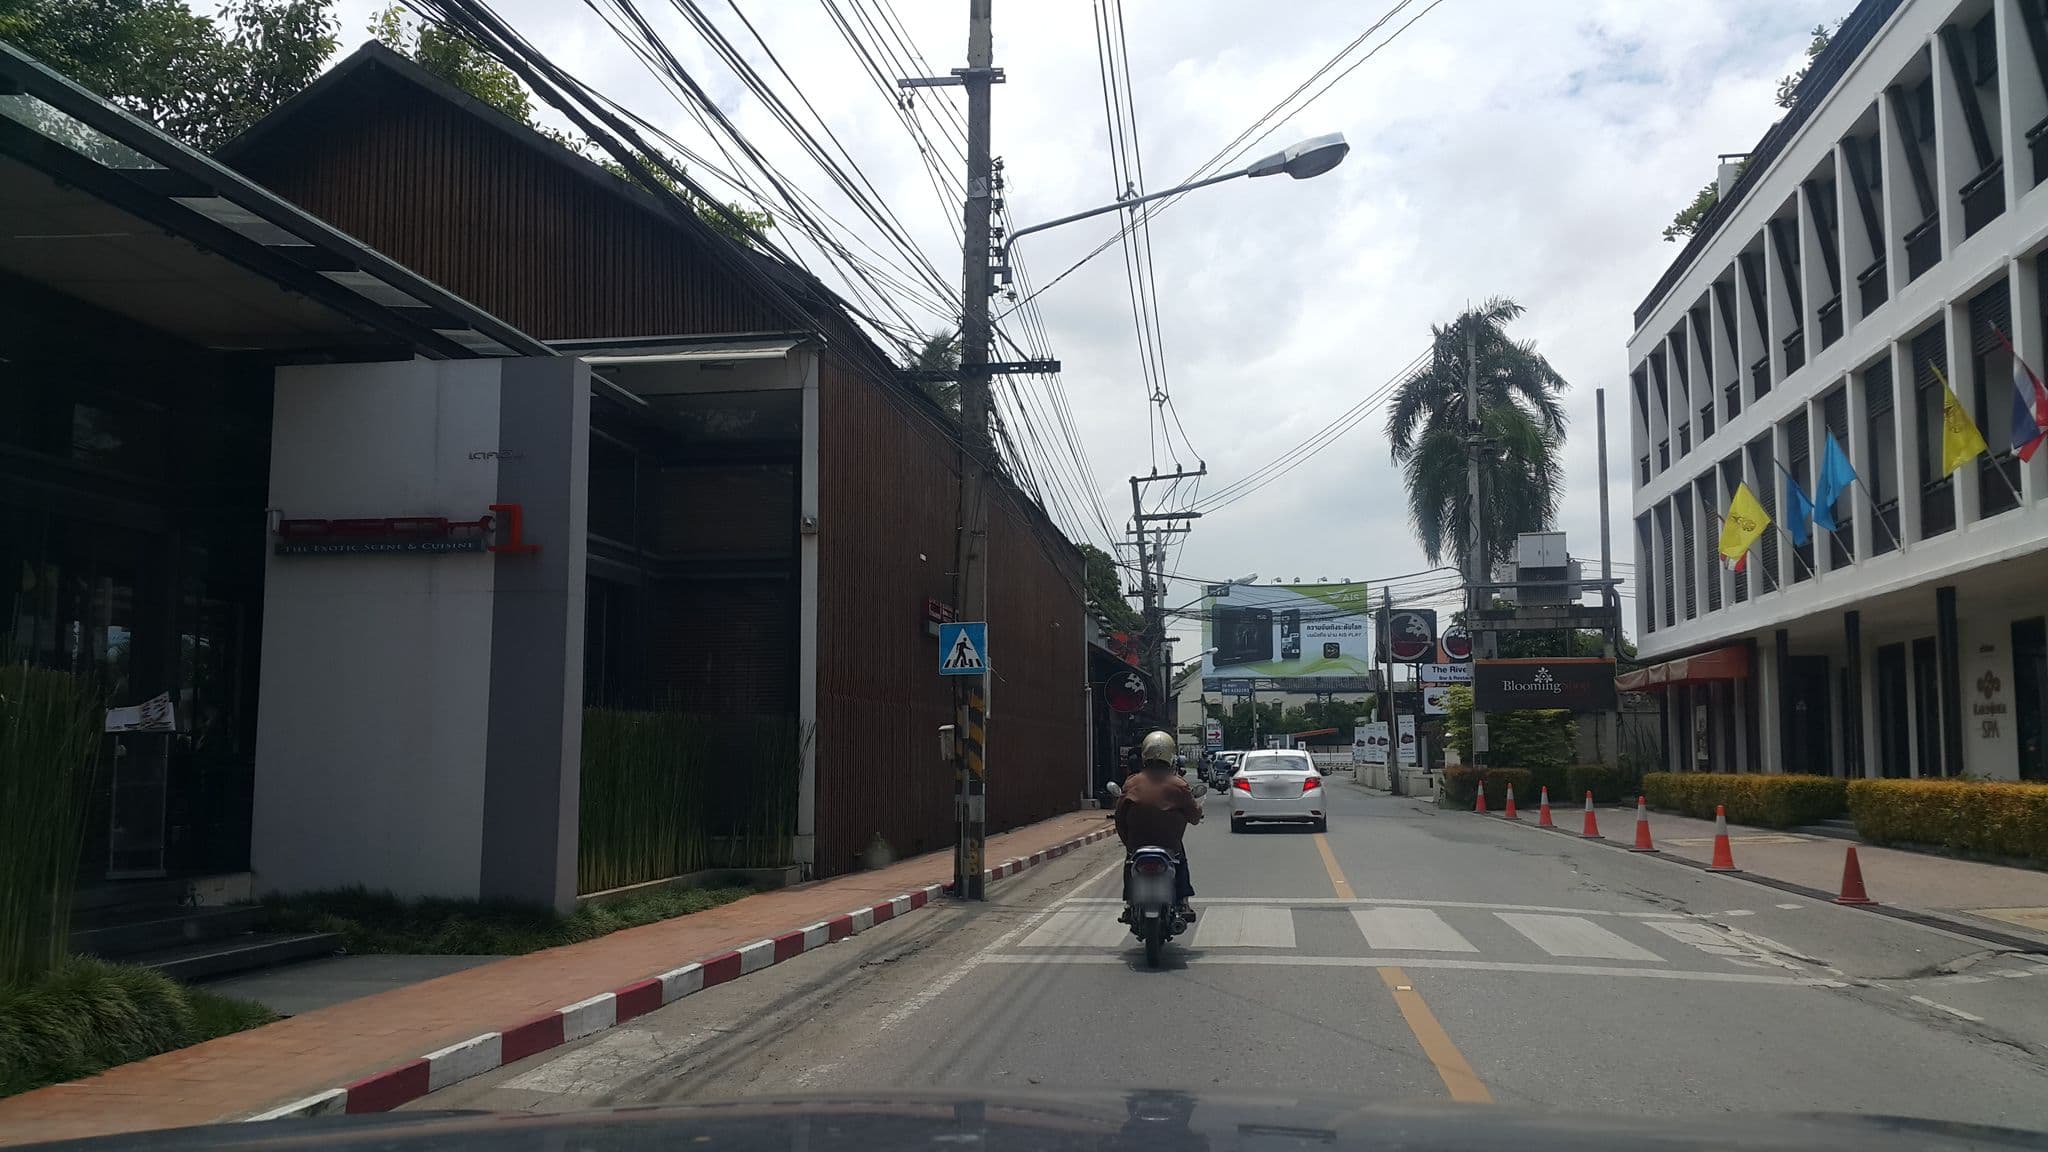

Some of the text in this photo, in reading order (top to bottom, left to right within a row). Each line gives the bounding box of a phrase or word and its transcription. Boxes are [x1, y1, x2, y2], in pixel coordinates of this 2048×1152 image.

[1342, 593, 1361, 602] AIS
[1450, 665, 1467, 673] Rive
[1502, 680, 1562, 694] Blooming
